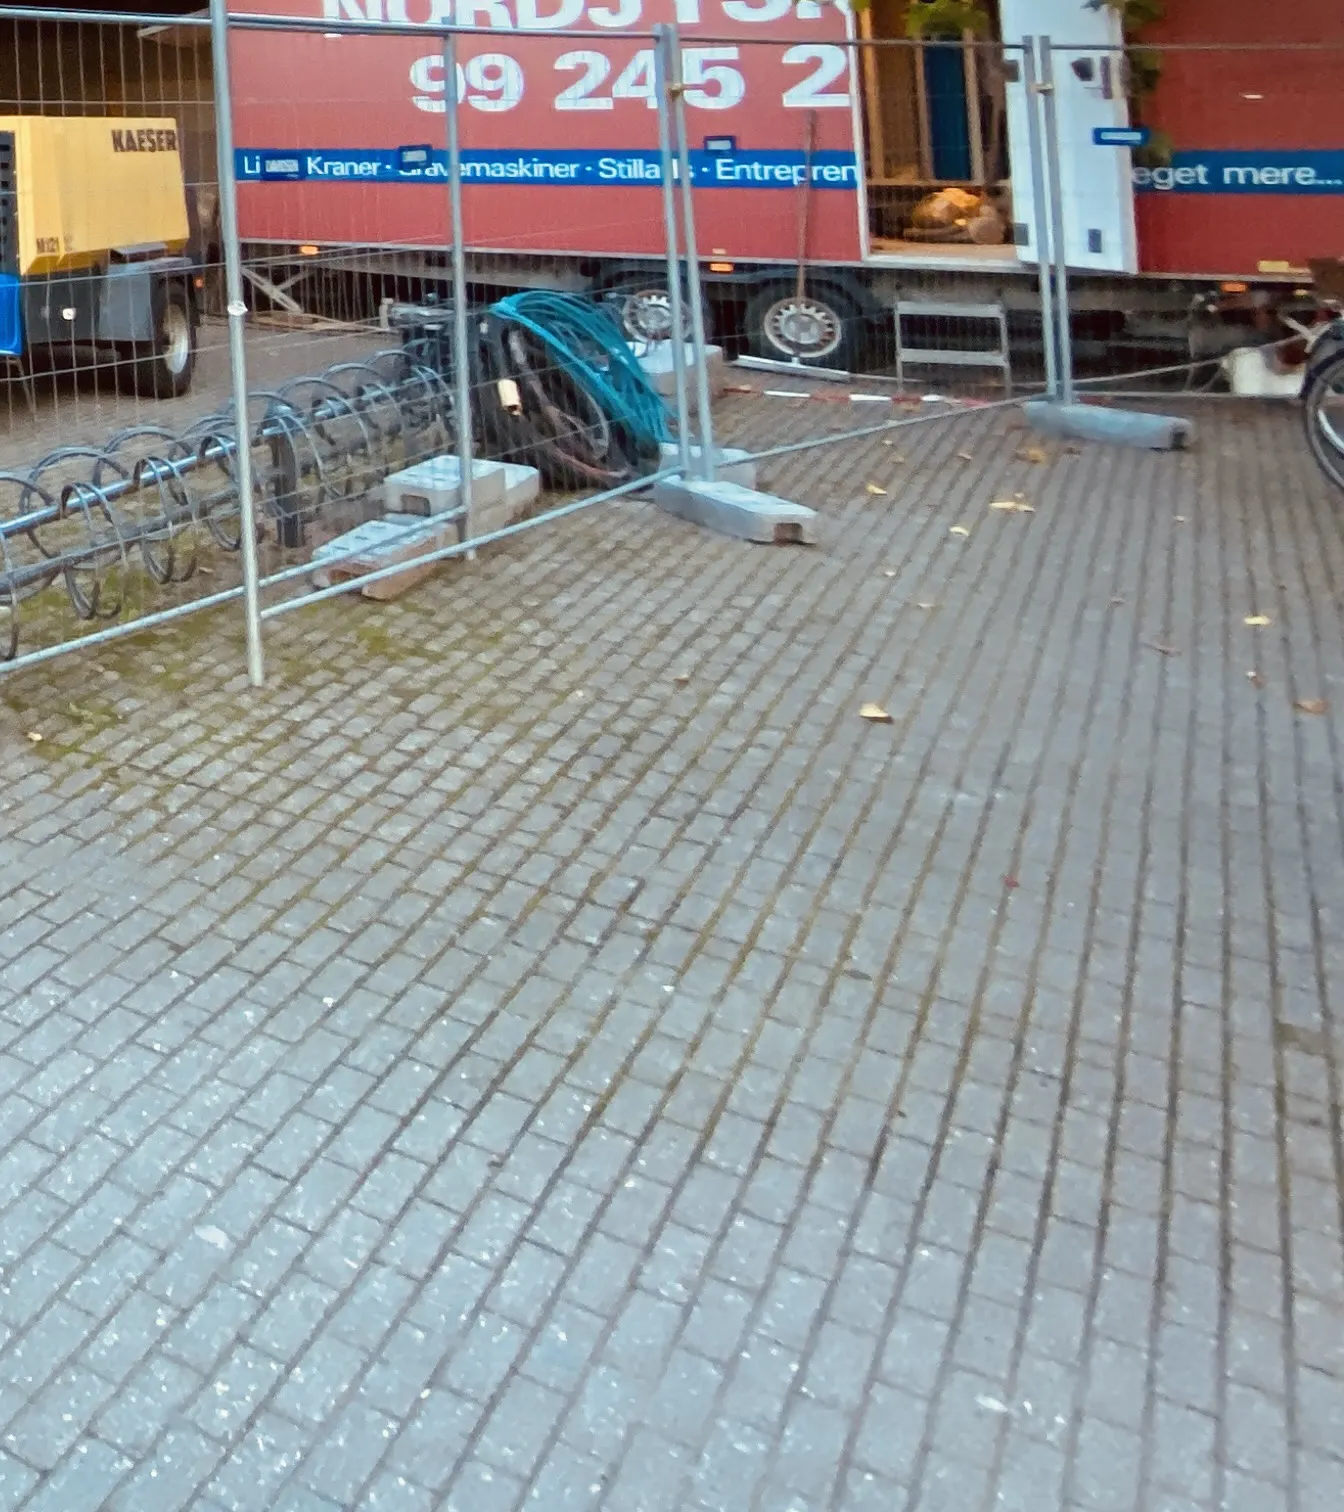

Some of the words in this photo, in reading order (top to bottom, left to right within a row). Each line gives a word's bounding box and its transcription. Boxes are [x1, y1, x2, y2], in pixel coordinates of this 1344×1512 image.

[409, 52, 525, 113] 99
[553, 45, 746, 111] 245
[781, 43, 852, 108] 2
[111, 128, 178, 153] KAESER
[306, 156, 382, 177] Kraner
[398, 157, 581, 179] avmaskiner
